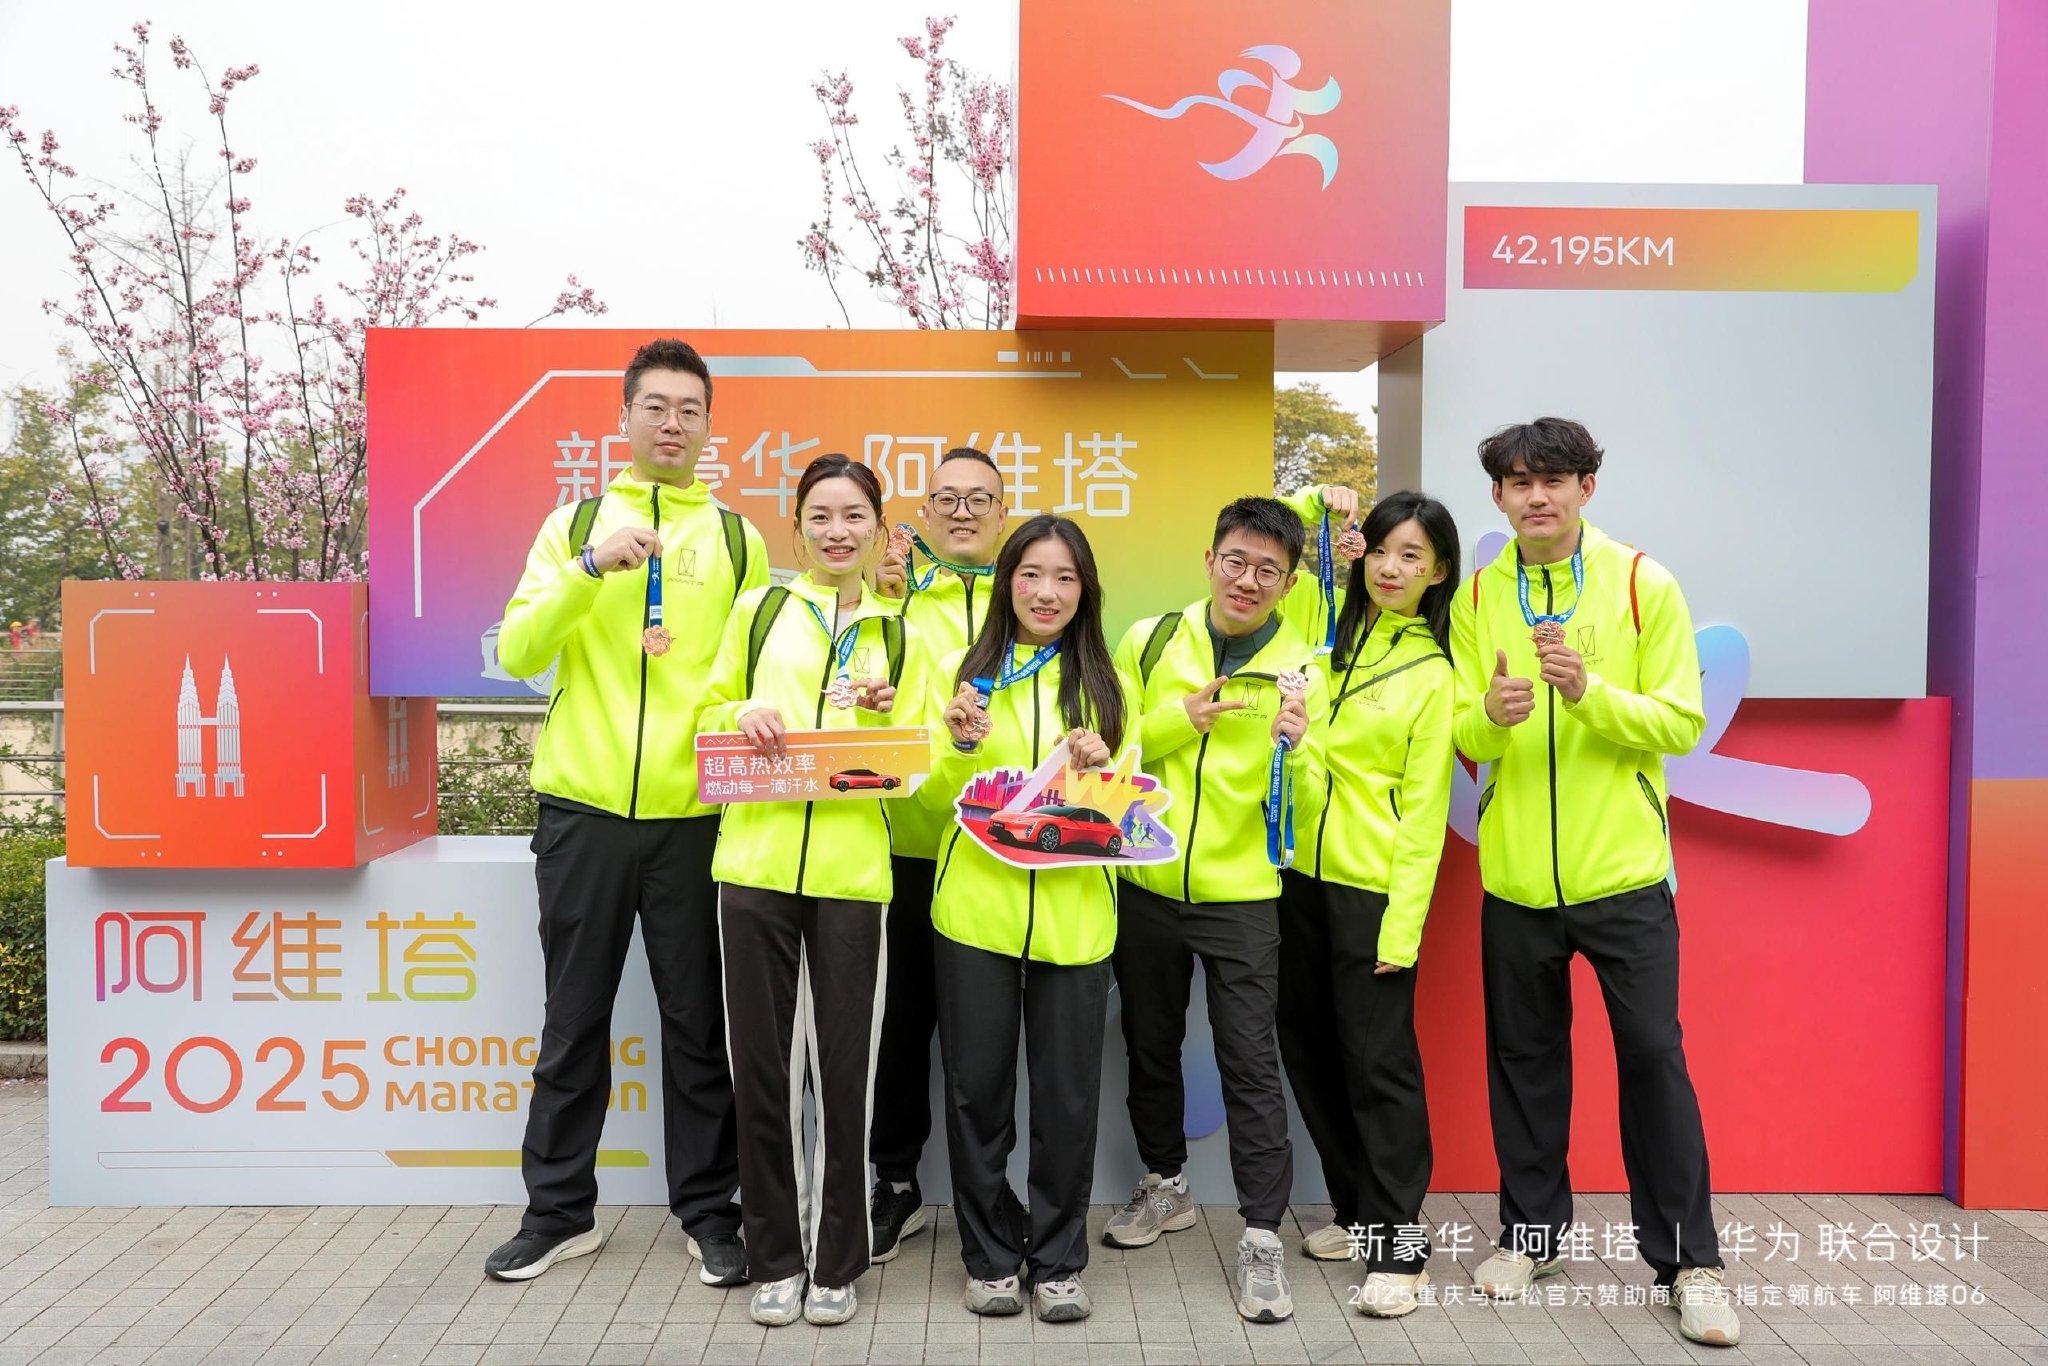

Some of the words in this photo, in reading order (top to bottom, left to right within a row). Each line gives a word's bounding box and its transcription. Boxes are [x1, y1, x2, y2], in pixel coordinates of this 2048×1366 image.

[1491, 235, 1675, 266] 42.195KM
[863, 431, 1139, 518] 阿维塔
[705, 736, 752, 746] AVAT
[703, 753, 817, 777] 超高热效率
[705, 777, 819, 796] 燃动每一滴汗水
[94, 911, 477, 1002] 阿维塔
[100, 1036, 370, 1113] 2025
[383, 1035, 647, 1067] CHONGG
